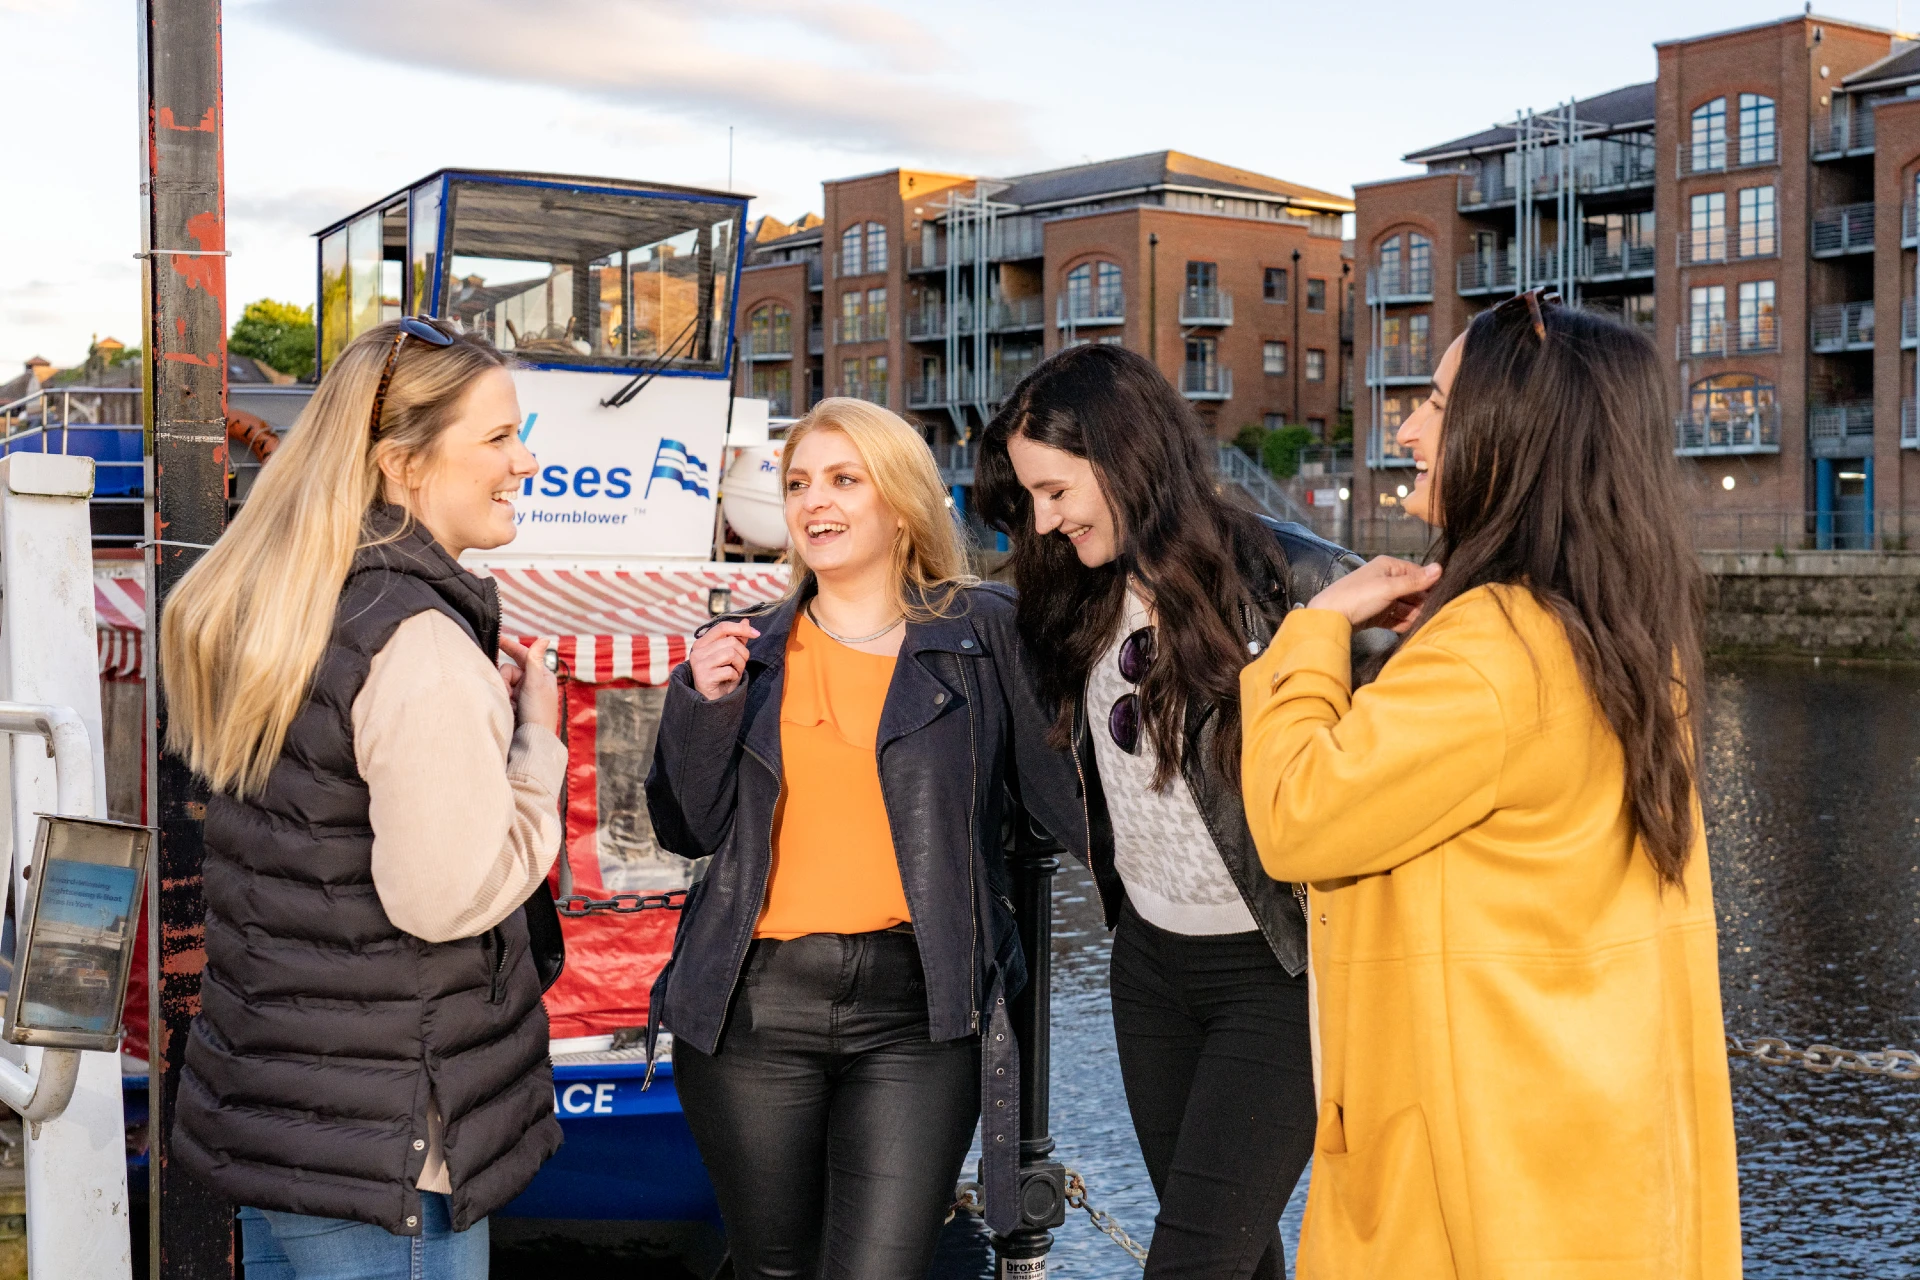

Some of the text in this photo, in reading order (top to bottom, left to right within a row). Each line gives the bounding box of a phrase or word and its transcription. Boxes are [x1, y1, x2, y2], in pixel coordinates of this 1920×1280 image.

[531, 510, 628, 525] Hornblower
[103, 893, 123, 903] Boat
[1006, 1259, 1046, 1272] broxap
